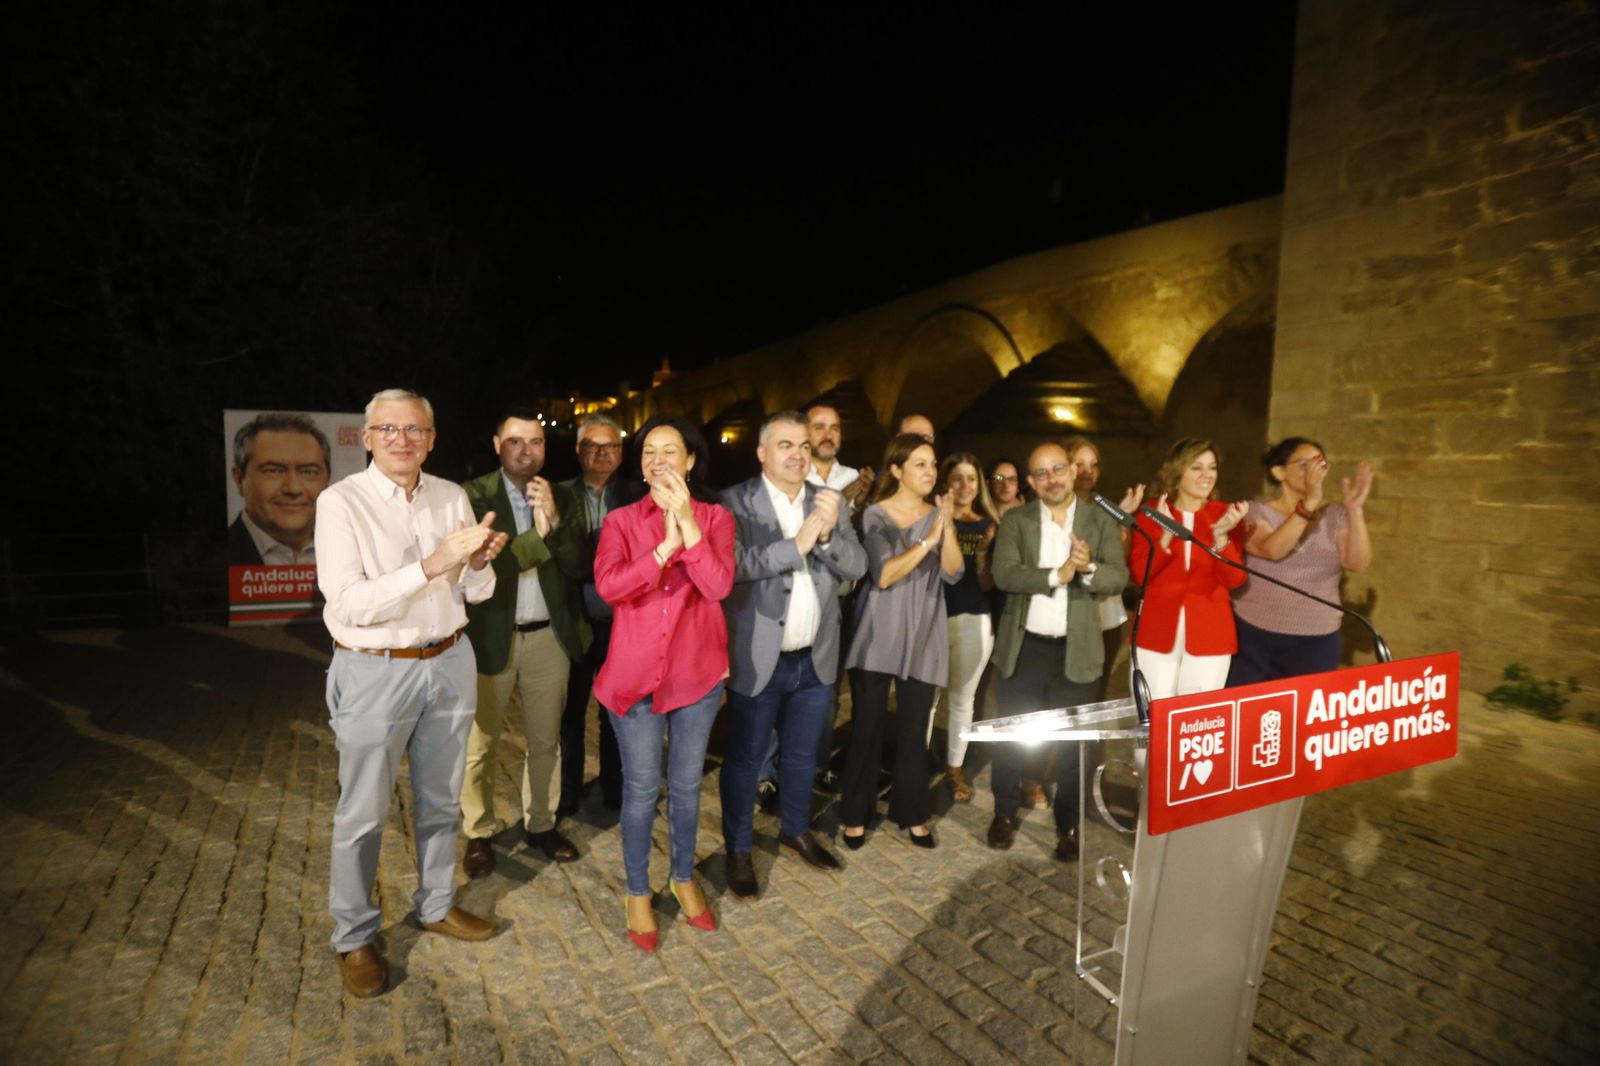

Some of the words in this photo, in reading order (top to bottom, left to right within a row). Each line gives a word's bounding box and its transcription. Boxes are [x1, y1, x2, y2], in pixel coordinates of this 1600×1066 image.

[242, 569, 316, 582] Andaluc
[242, 582, 294, 598] quiere
[1305, 666, 1446, 724] Andalucía
[1180, 716, 1225, 735] Andalucía
[1304, 719, 1389, 770] quiere
[1393, 703, 1451, 741] más.
[1179, 731, 1225, 762] PSOE
